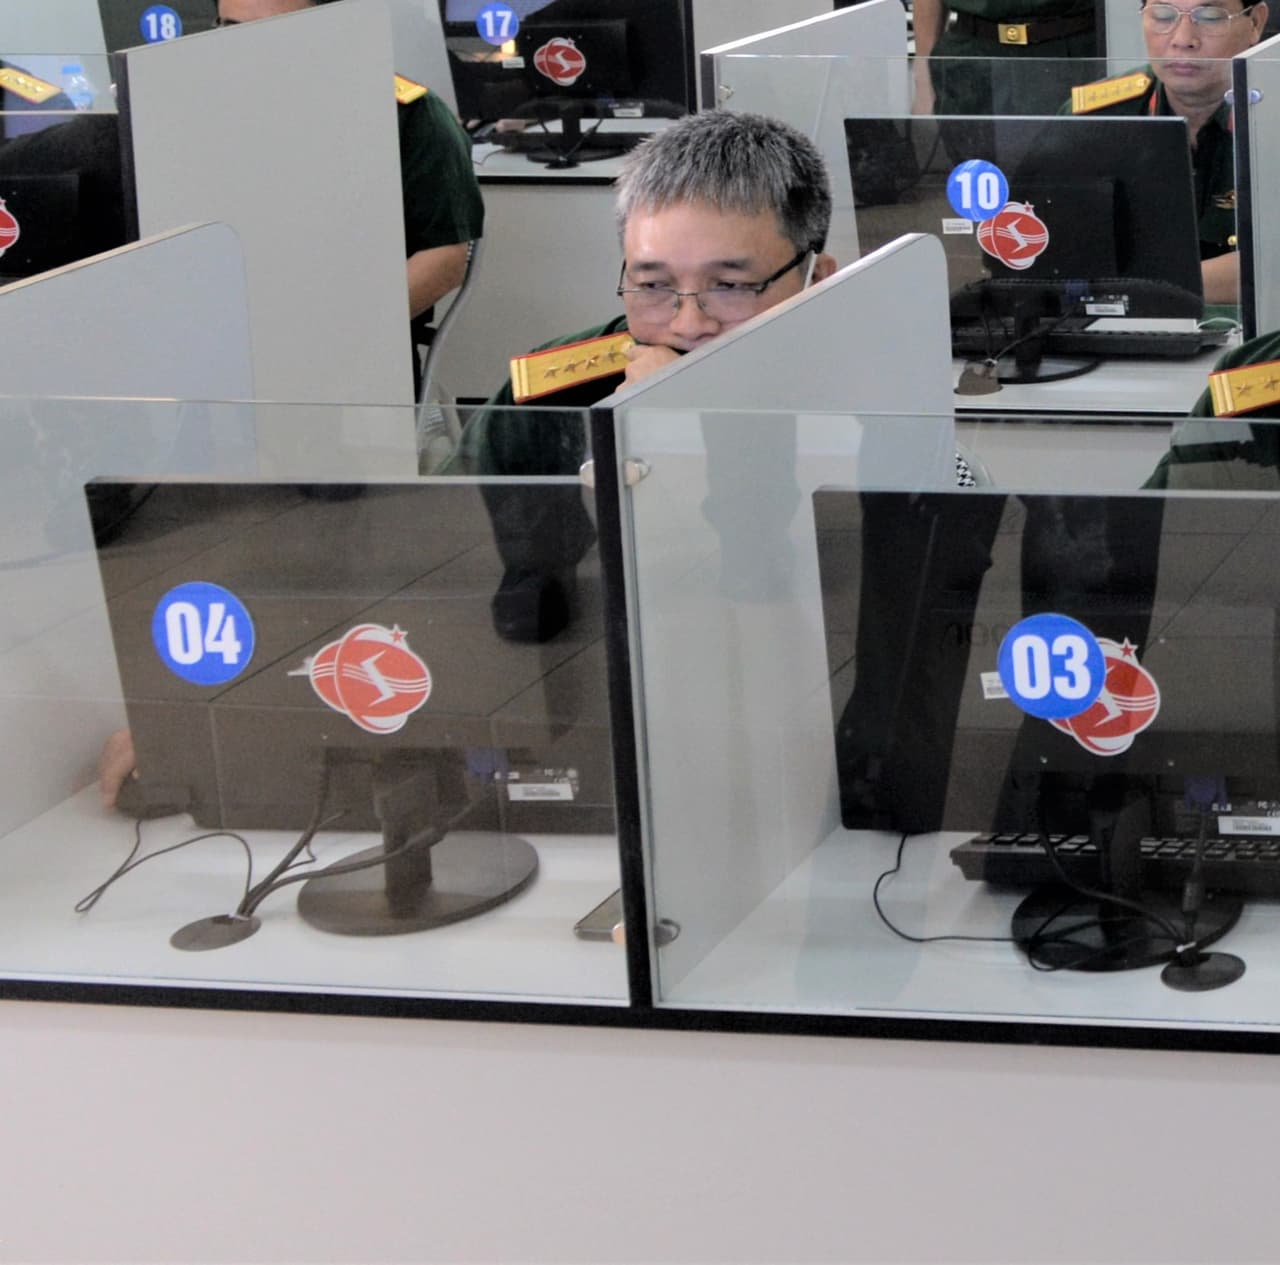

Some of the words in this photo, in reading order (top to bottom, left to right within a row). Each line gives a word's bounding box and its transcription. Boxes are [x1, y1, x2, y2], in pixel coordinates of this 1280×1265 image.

[145, 13, 177, 40] 18
[481, 10, 513, 37] 17
[955, 171, 1000, 210] 10
[165, 601, 242, 666] 04
[1012, 634, 1092, 700] 03
